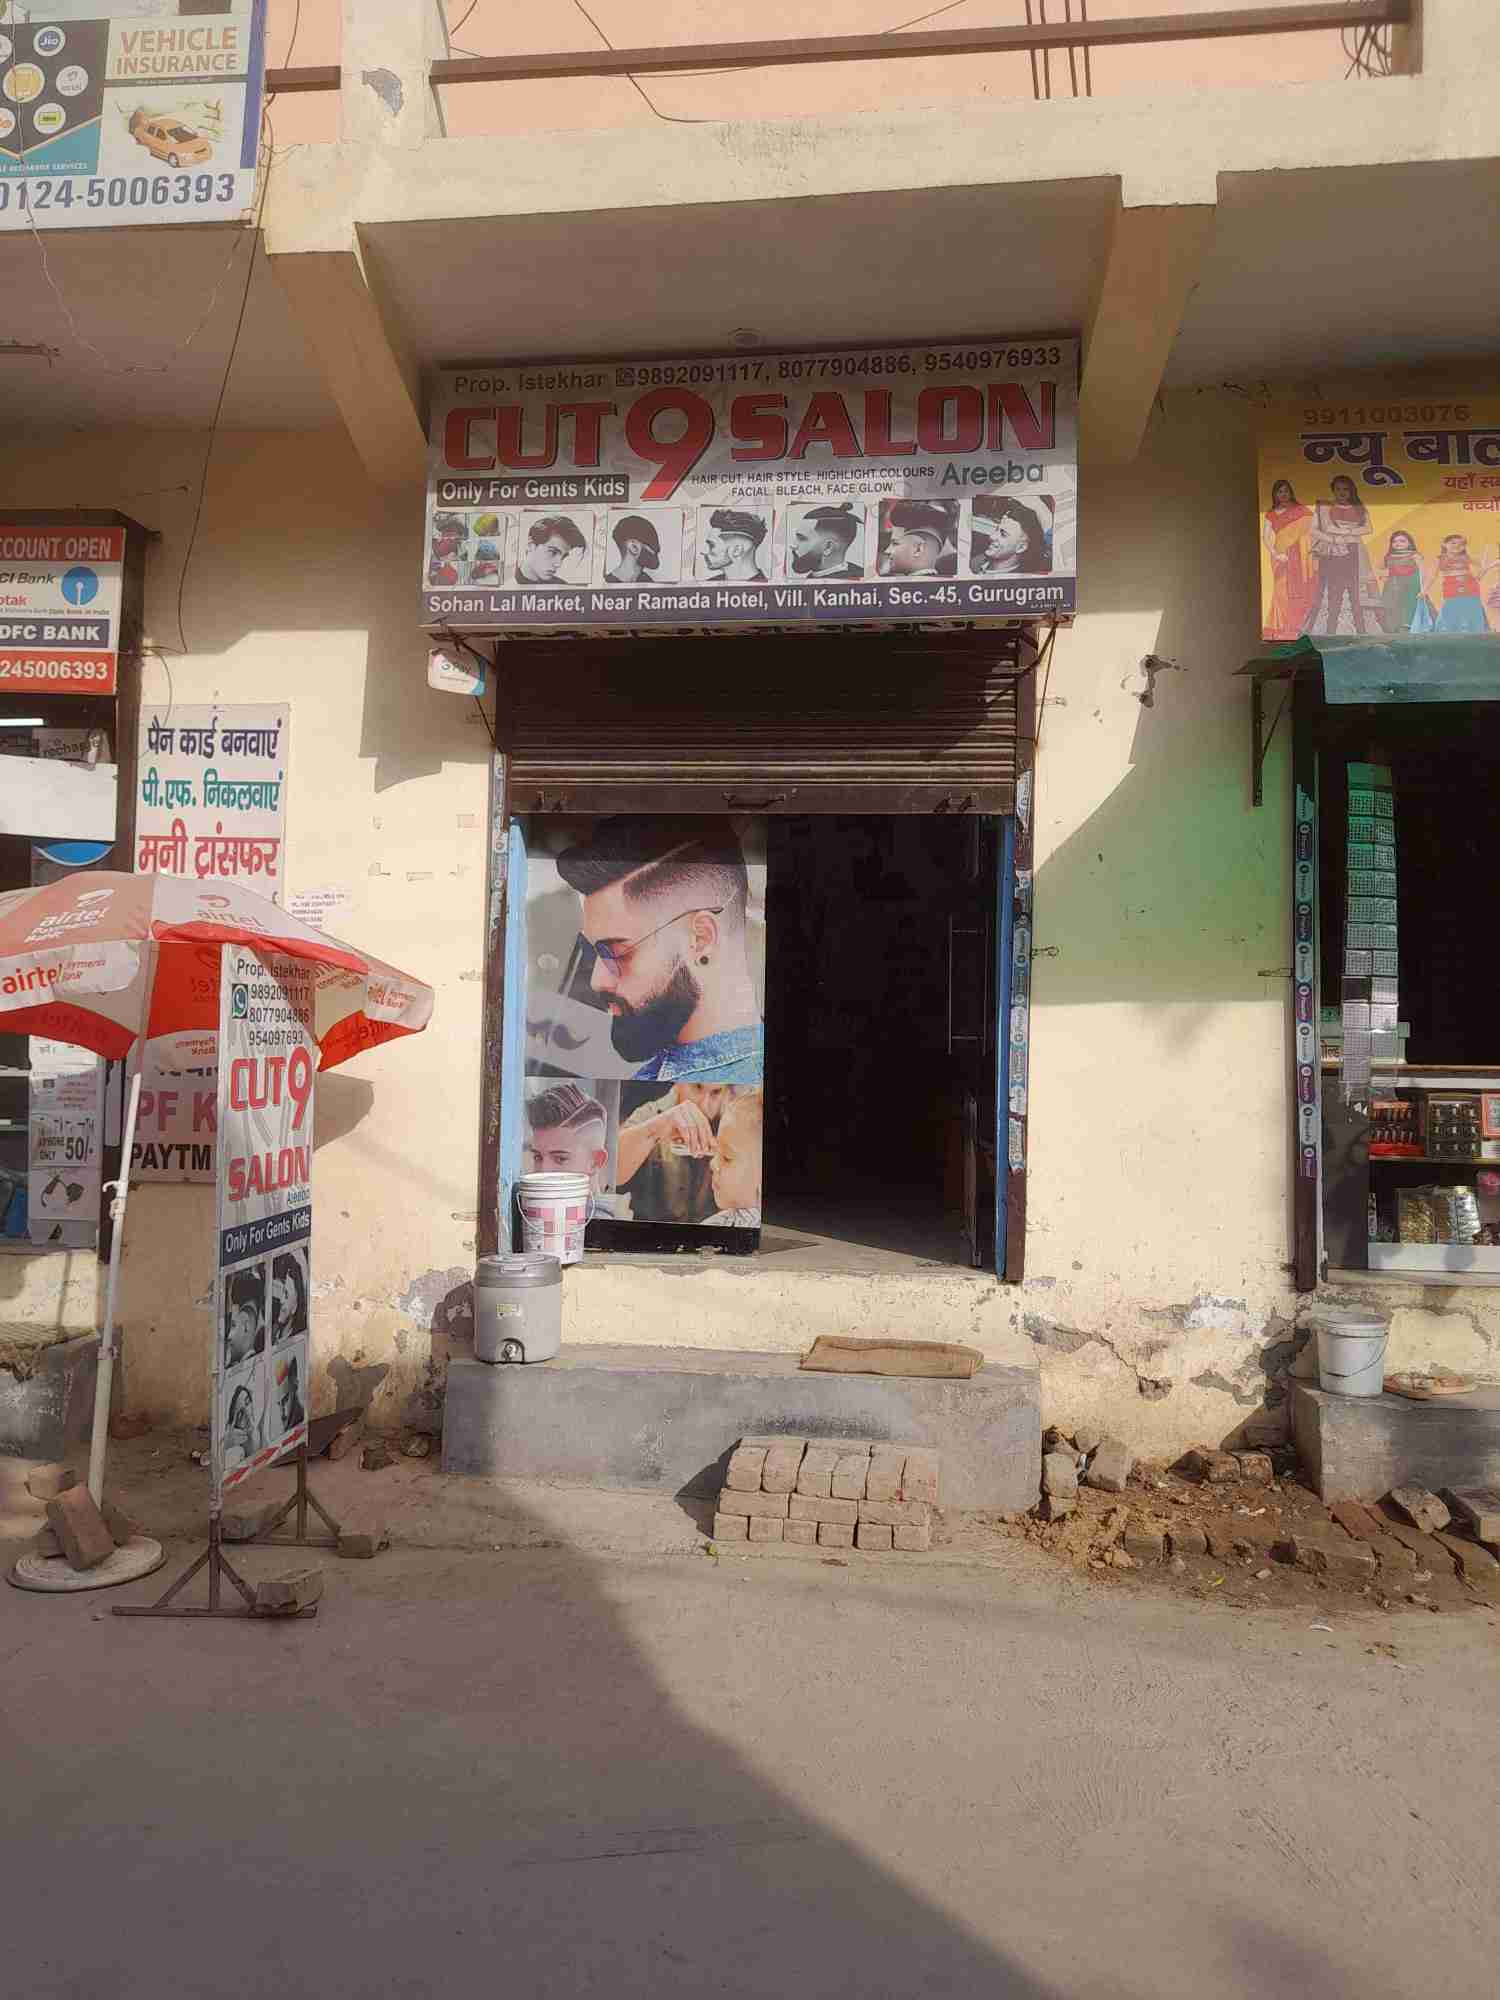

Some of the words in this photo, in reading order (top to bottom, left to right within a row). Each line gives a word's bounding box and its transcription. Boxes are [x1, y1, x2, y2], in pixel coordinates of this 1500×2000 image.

[121, 26, 239, 53] VEHICLE
[115, 53, 238, 75] INSURANCE
[0, 173, 235, 210] 0124-5006393
[455, 375, 511, 393] Prop.
[518, 371, 606, 391] Istekhar
[445, 401, 618, 471] CUT
[625, 386, 716, 501] 9
[730, 380, 1057, 462] SALON
[941, 459, 1044, 486] Areeba
[1301, 431, 1405, 486] न्यू
[692, 473, 718, 484] HAIR
[747, 471, 773, 483] HAIR
[817, 468, 878, 481] HIGHLIGHT
[880, 465, 935, 479] COLOURS
[827, 482, 856, 495] FACE
[441, 481, 482, 504] Only
[489, 480, 519, 500] For
[524, 478, 579, 498] Gents
[584, 476, 625, 497] Kids
[0, 537, 62, 560] COUNT
[64, 537, 112, 560] OPEN
[17, 572, 57, 585] Bank
[429, 594, 485, 614] Sohan
[490, 593, 517, 612] Lal
[521, 592, 586, 614] Market,
[591, 591, 633, 611] Near
[638, 590, 711, 610] Ramada
[716, 588, 769, 611] Hotel,
[775, 588, 808, 607] Vill.
[814, 586, 883, 607] Kanhai,
[888, 584, 962, 605] Sec.-45,
[968, 583, 1065, 606] Gurugram
[43, 625, 100, 641] BANK
[0, 659, 108, 679] 245006393
[147, 714, 176, 756] पैन
[179, 715, 219, 759] कार्ड
[221, 717, 283, 760] बनवाएं
[138, 817, 189, 874] मनी
[194, 820, 281, 880] ट्रांसफर
[40, 905, 110, 928] airtel
[2, 962, 63, 994] airtel
[237, 958, 267, 980] Prop.
[230, 1055, 287, 1111] CUT
[288, 1046, 313, 1131] 9
[135, 1090, 179, 1133] PF
[130, 1143, 212, 1171] PAYTM
[228, 1147, 310, 1201] SALON
[225, 1231, 248, 1253] Only
[250, 1226, 265, 1244] For
[266, 1217, 291, 1239] Gents
[292, 1211, 310, 1232] Kids
